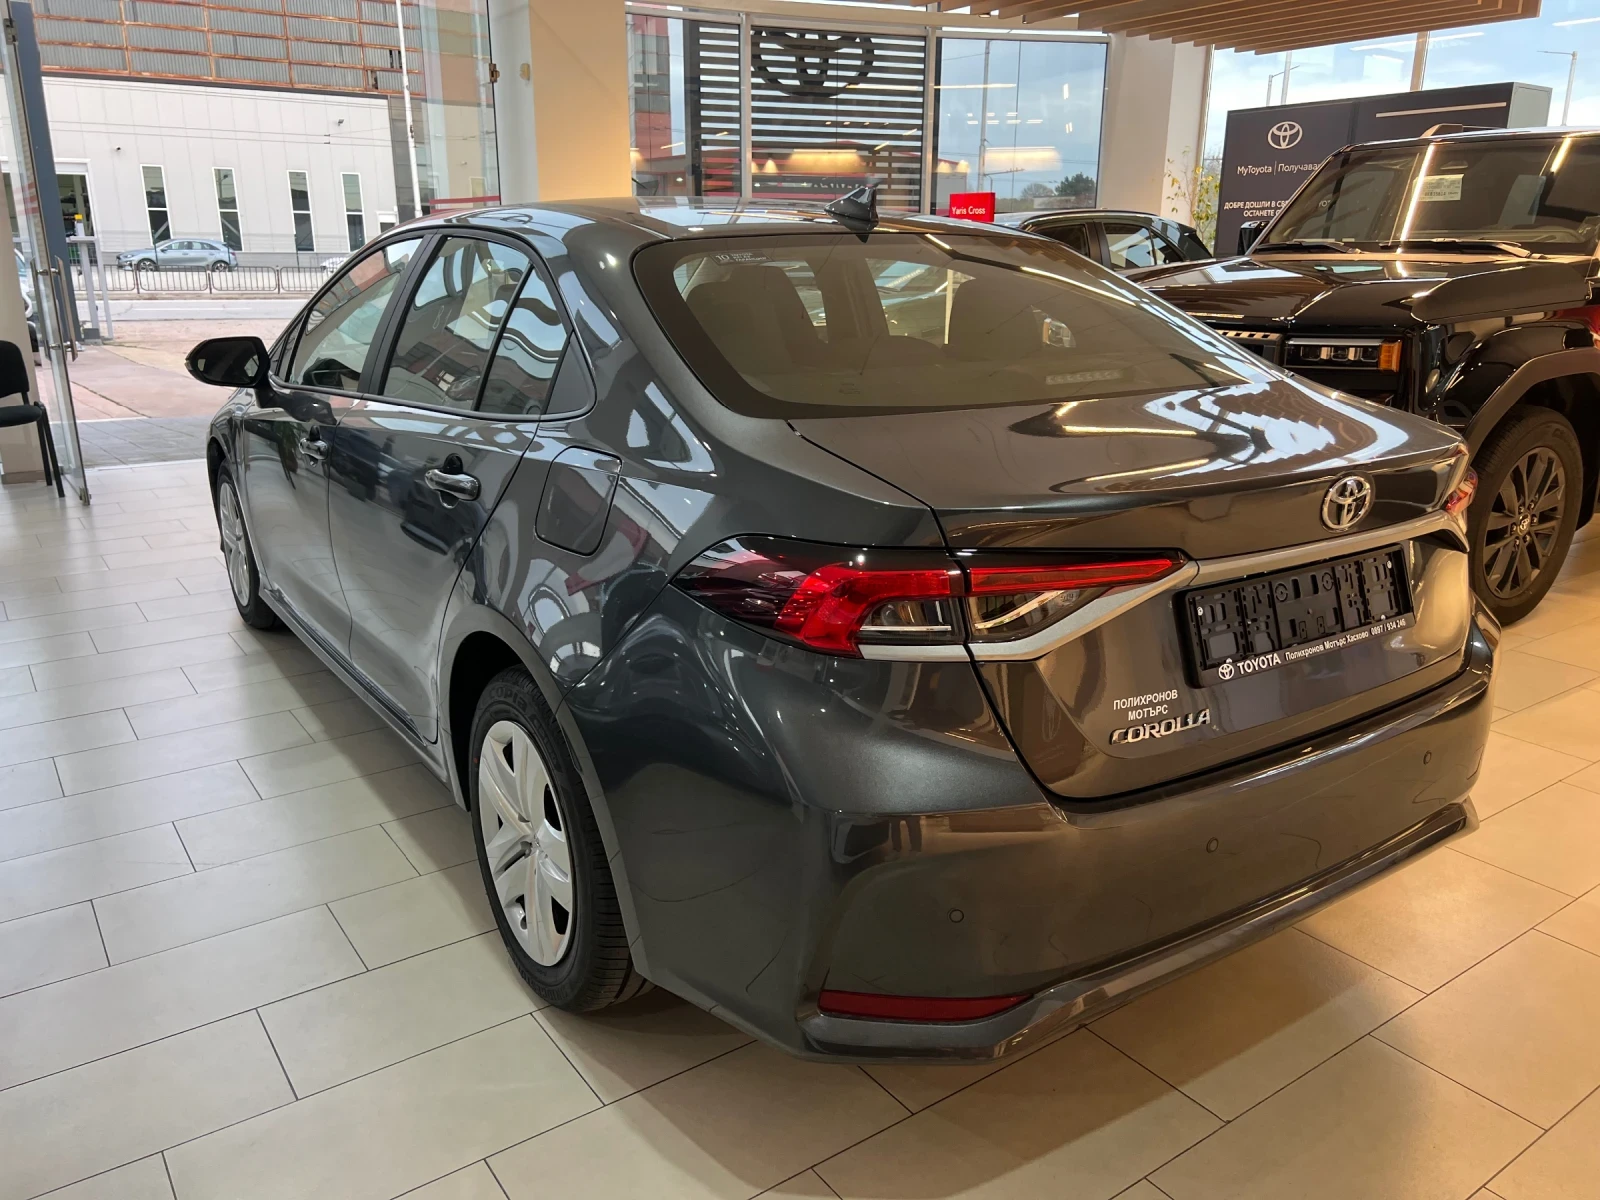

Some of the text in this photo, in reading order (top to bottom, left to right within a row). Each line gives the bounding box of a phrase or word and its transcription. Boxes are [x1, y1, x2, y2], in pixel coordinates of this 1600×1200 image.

[1237, 165, 1272, 176] MyToyota
[952, 206, 986, 214] Yaris Cross
[1224, 201, 1244, 210] ДОБРЕ
[1245, 200, 1270, 209] ДОШЛИ
[1243, 209, 1274, 217] ОСТАНЕТЕ
[1237, 653, 1281, 674] TOYOTA
[1285, 644, 1324, 661] Полихронов
[1324, 636, 1347, 650] Мотърс
[1346, 631, 1369, 643] Хасково
[1370, 625, 1384, 636] 0897
[1386, 622, 1397, 631] 934
[1113, 689, 1178, 711] ПОЛИХРОНОВ
[1128, 704, 1169, 721] МОТЪРС
[1109, 708, 1211, 745] COROLLA
